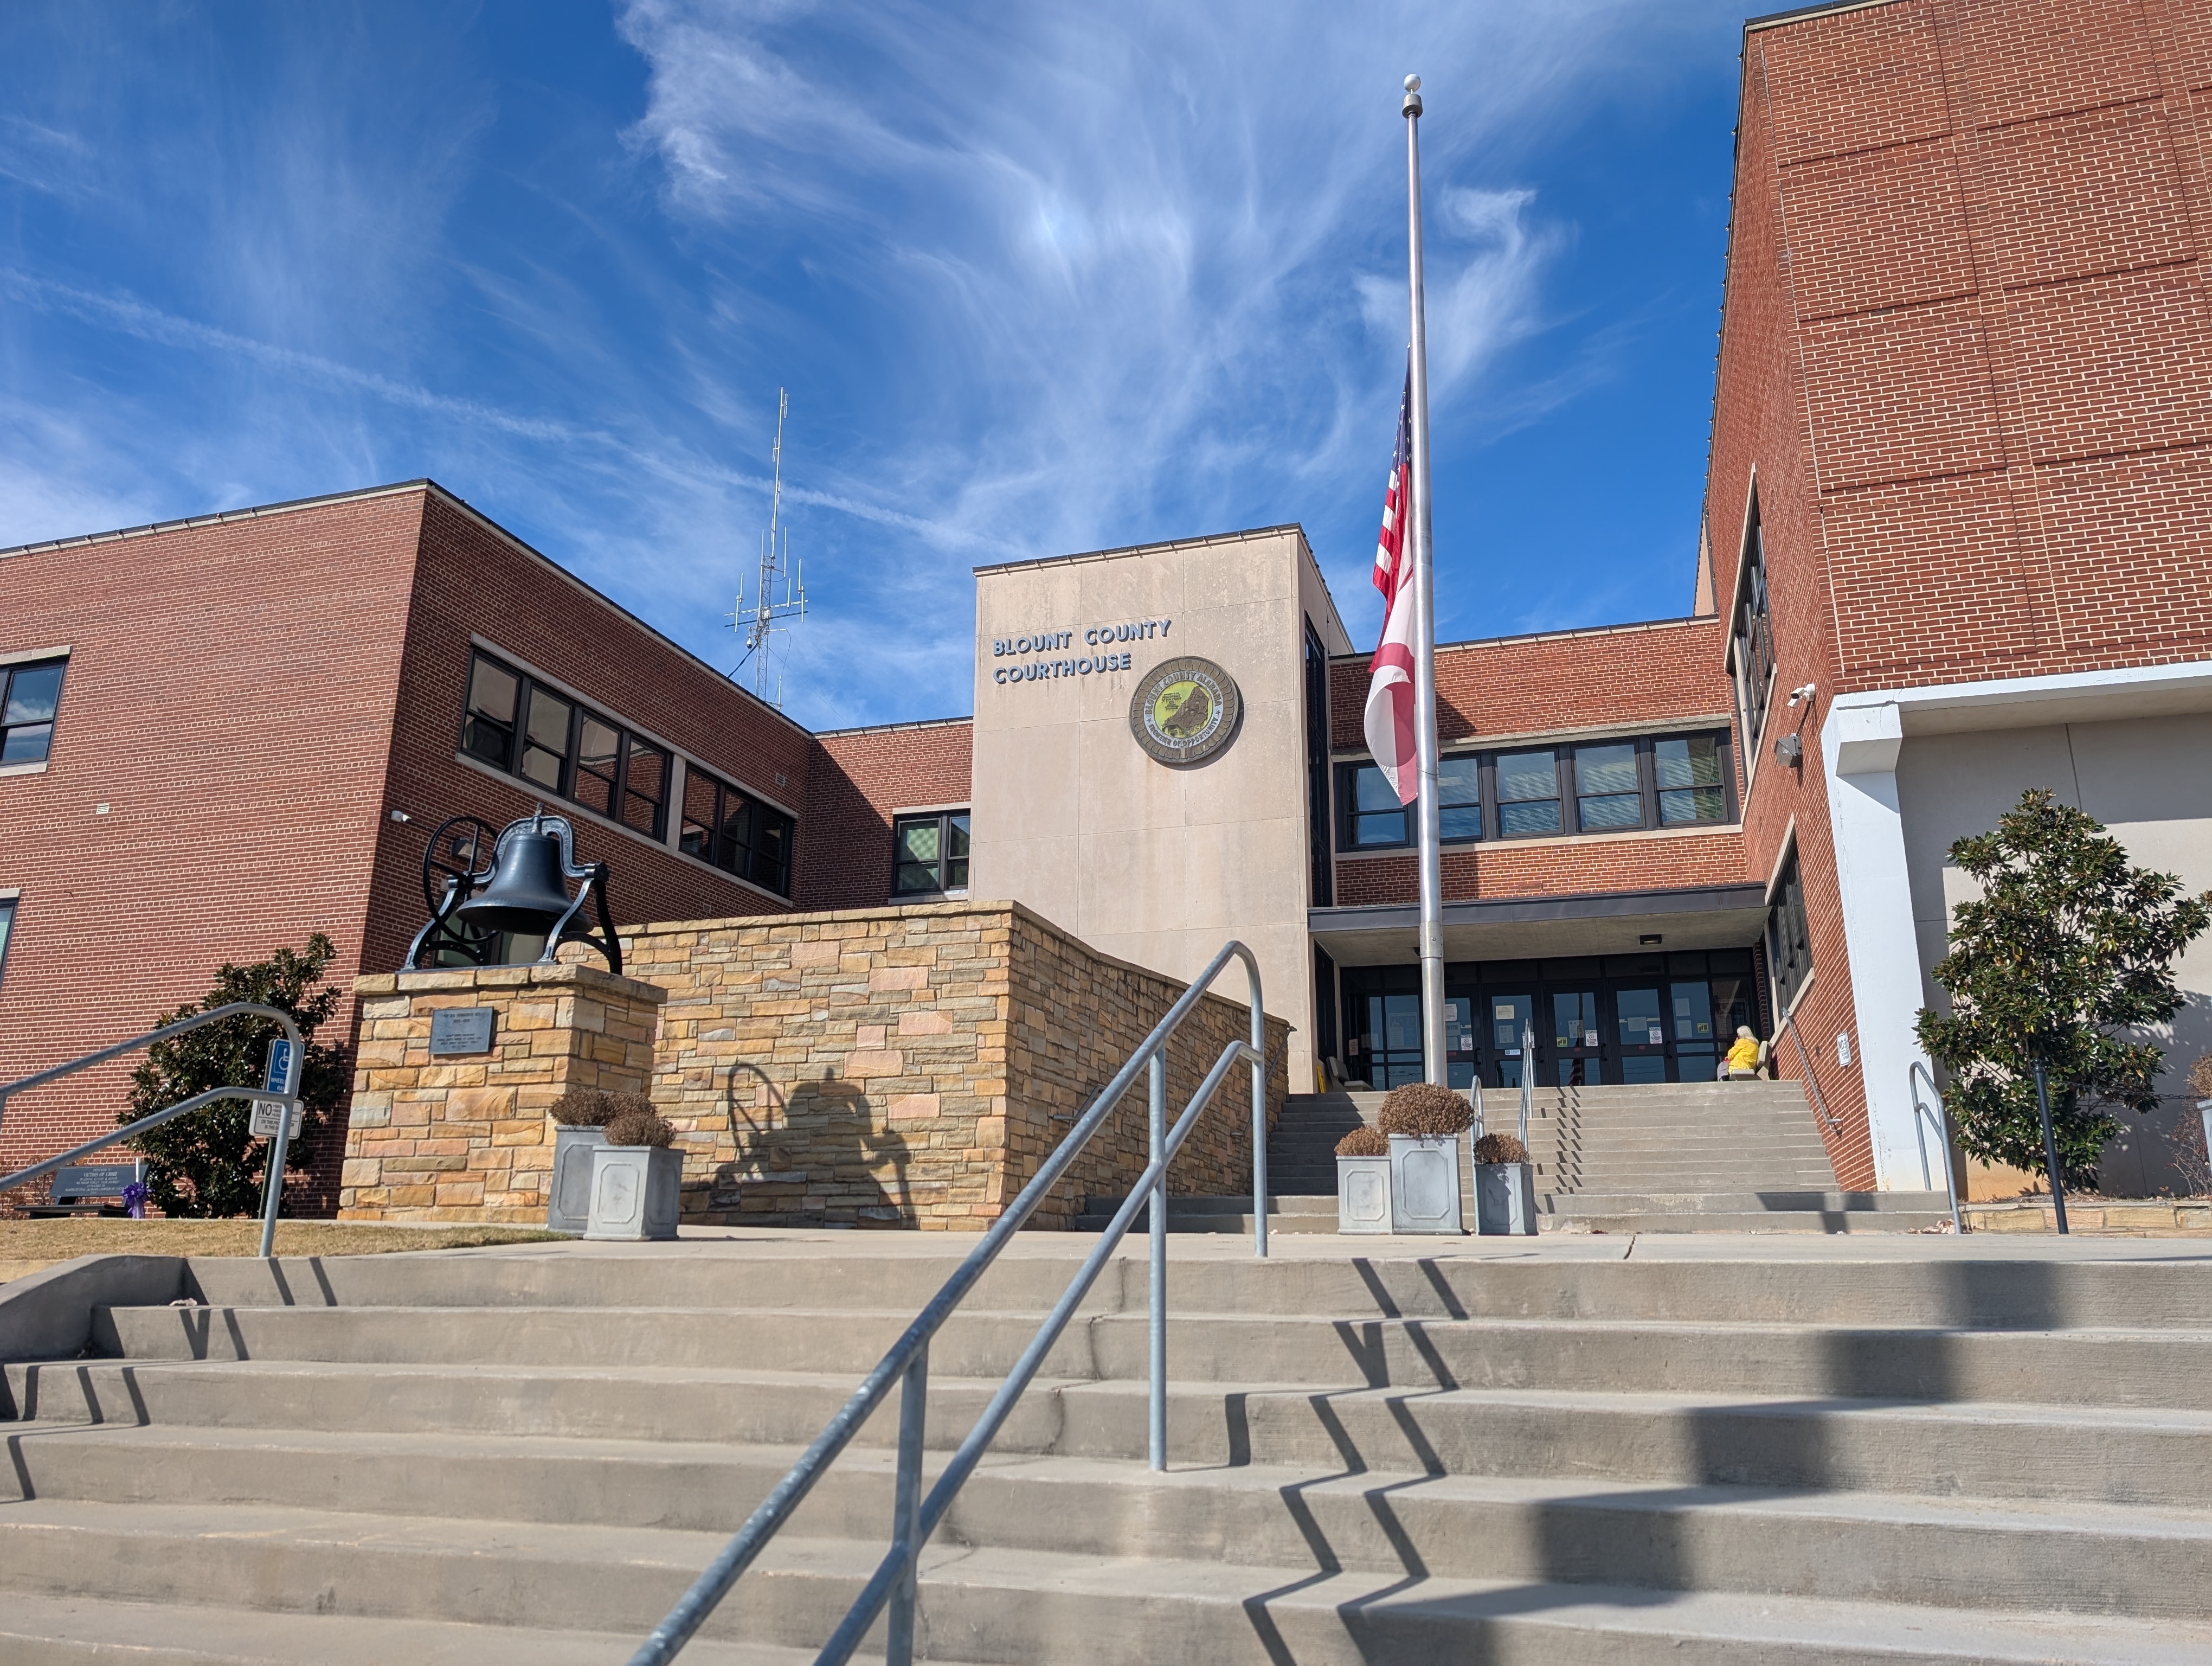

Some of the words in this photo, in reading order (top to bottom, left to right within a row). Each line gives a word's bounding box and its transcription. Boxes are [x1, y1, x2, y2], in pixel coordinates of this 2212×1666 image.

[993, 631, 1072, 656] BLOUNT
[1084, 619, 1172, 645] COUNTY
[993, 652, 1131, 684] COURTHOUSE
[1145, 683, 1163, 715] BLOUNT
[1162, 671, 1196, 685] COUNTY
[1196, 674, 1222, 707] ALABAMA
[1148, 724, 1172, 745] FRONTIER
[1182, 716, 1218, 747] OPPORTUNITY
[259, 1103, 272, 1116] NO
